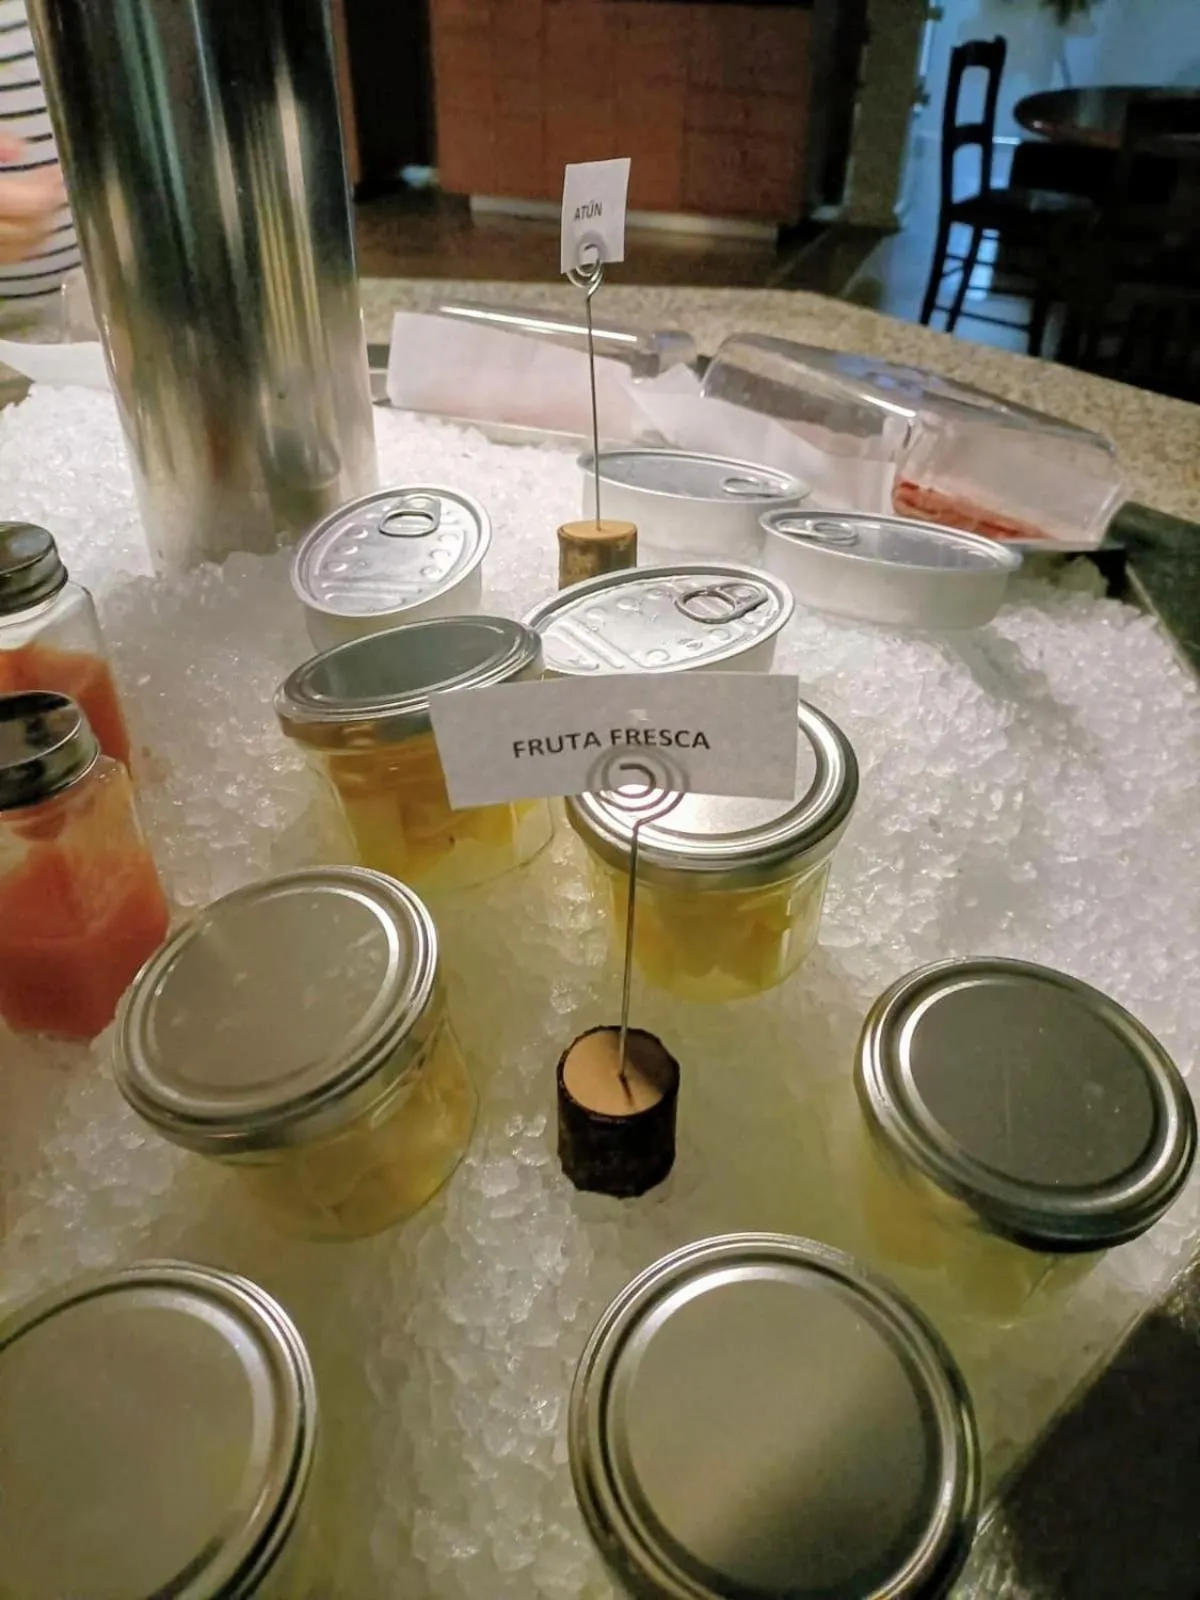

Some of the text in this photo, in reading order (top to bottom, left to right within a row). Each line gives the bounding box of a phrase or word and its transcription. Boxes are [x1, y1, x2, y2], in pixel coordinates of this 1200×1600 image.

[574, 200, 603, 221] ATÚN
[513, 728, 711, 758] FRUTA FRESCA
